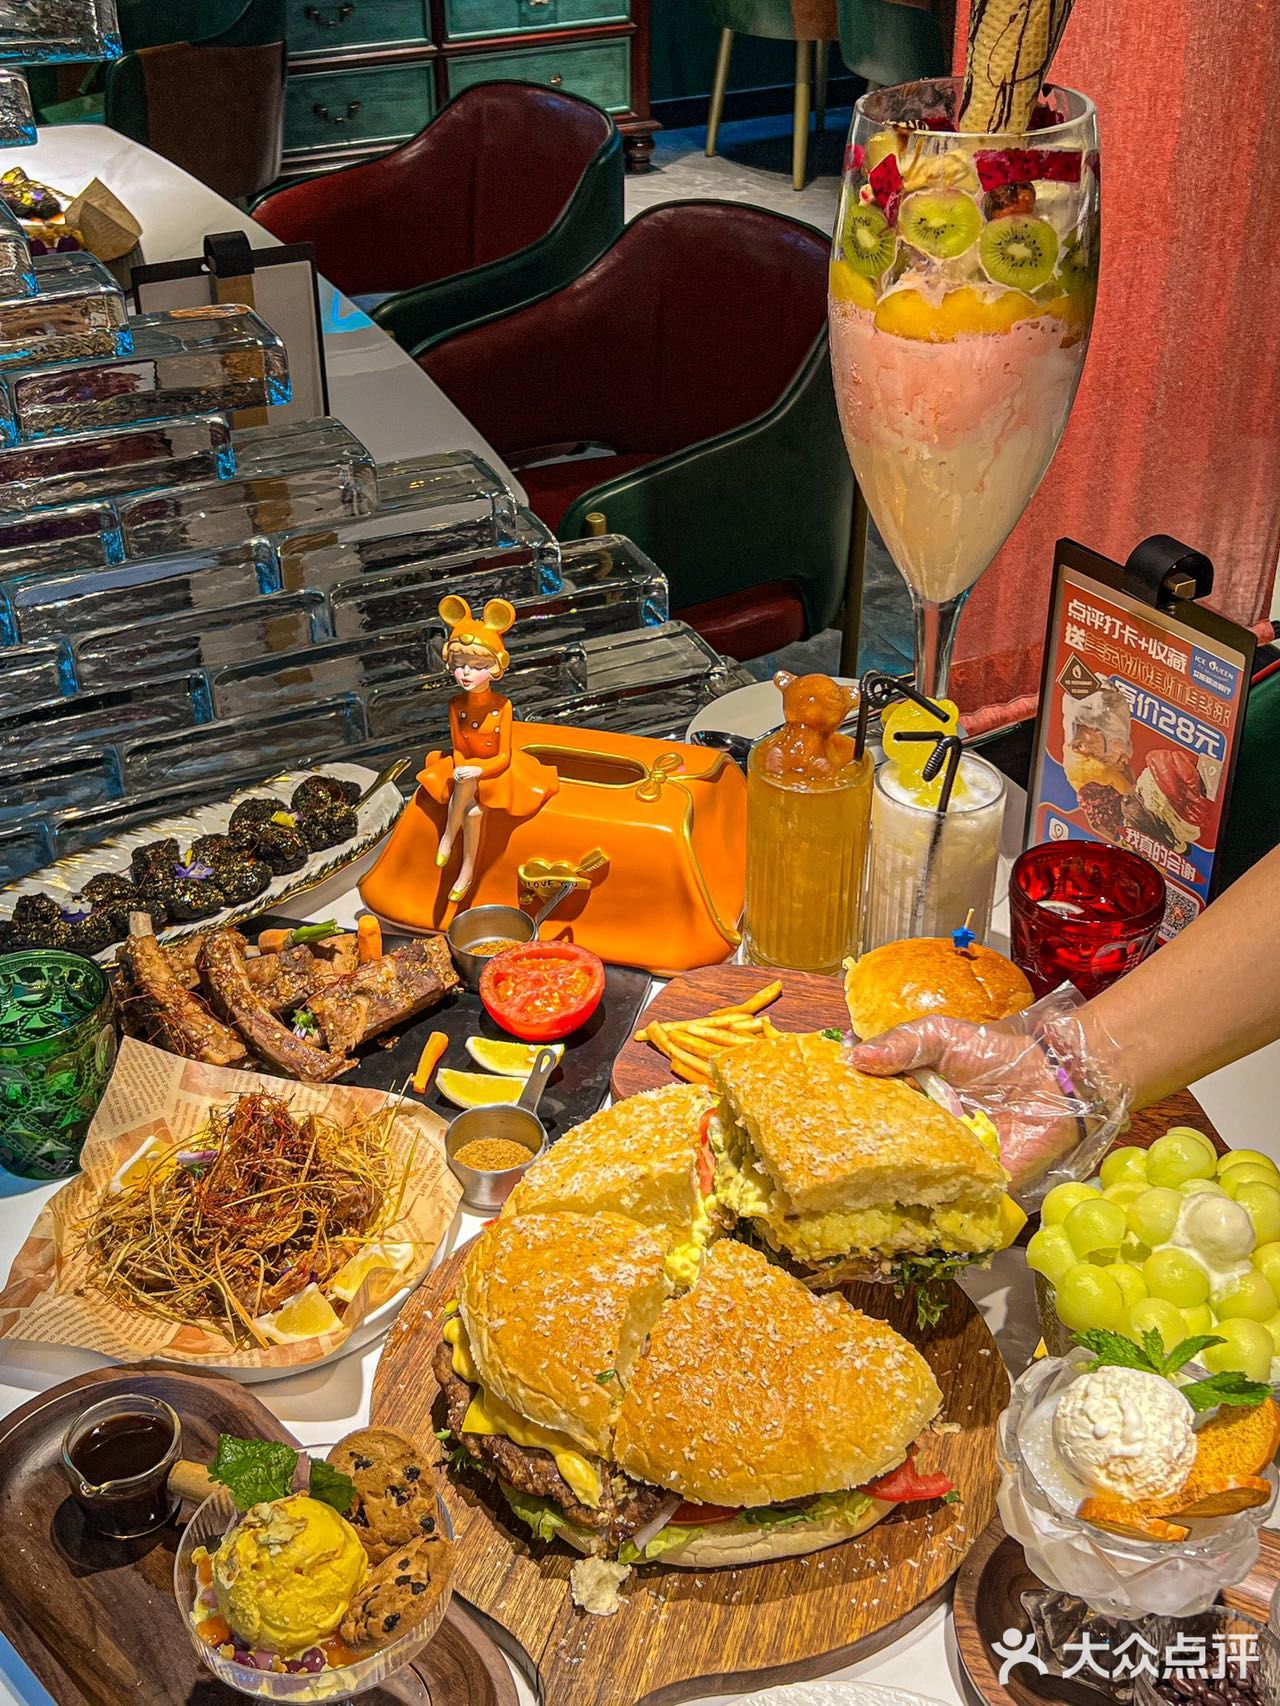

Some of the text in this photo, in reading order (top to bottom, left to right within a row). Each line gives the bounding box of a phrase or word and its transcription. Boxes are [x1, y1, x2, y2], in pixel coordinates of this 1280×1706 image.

[1067, 598, 1188, 675] 点评打卡+收藏
[1194, 655, 1206, 666] ICE
[1208, 660, 1234, 680] QUEEN
[1125, 827, 1197, 882] 我真的会谢
